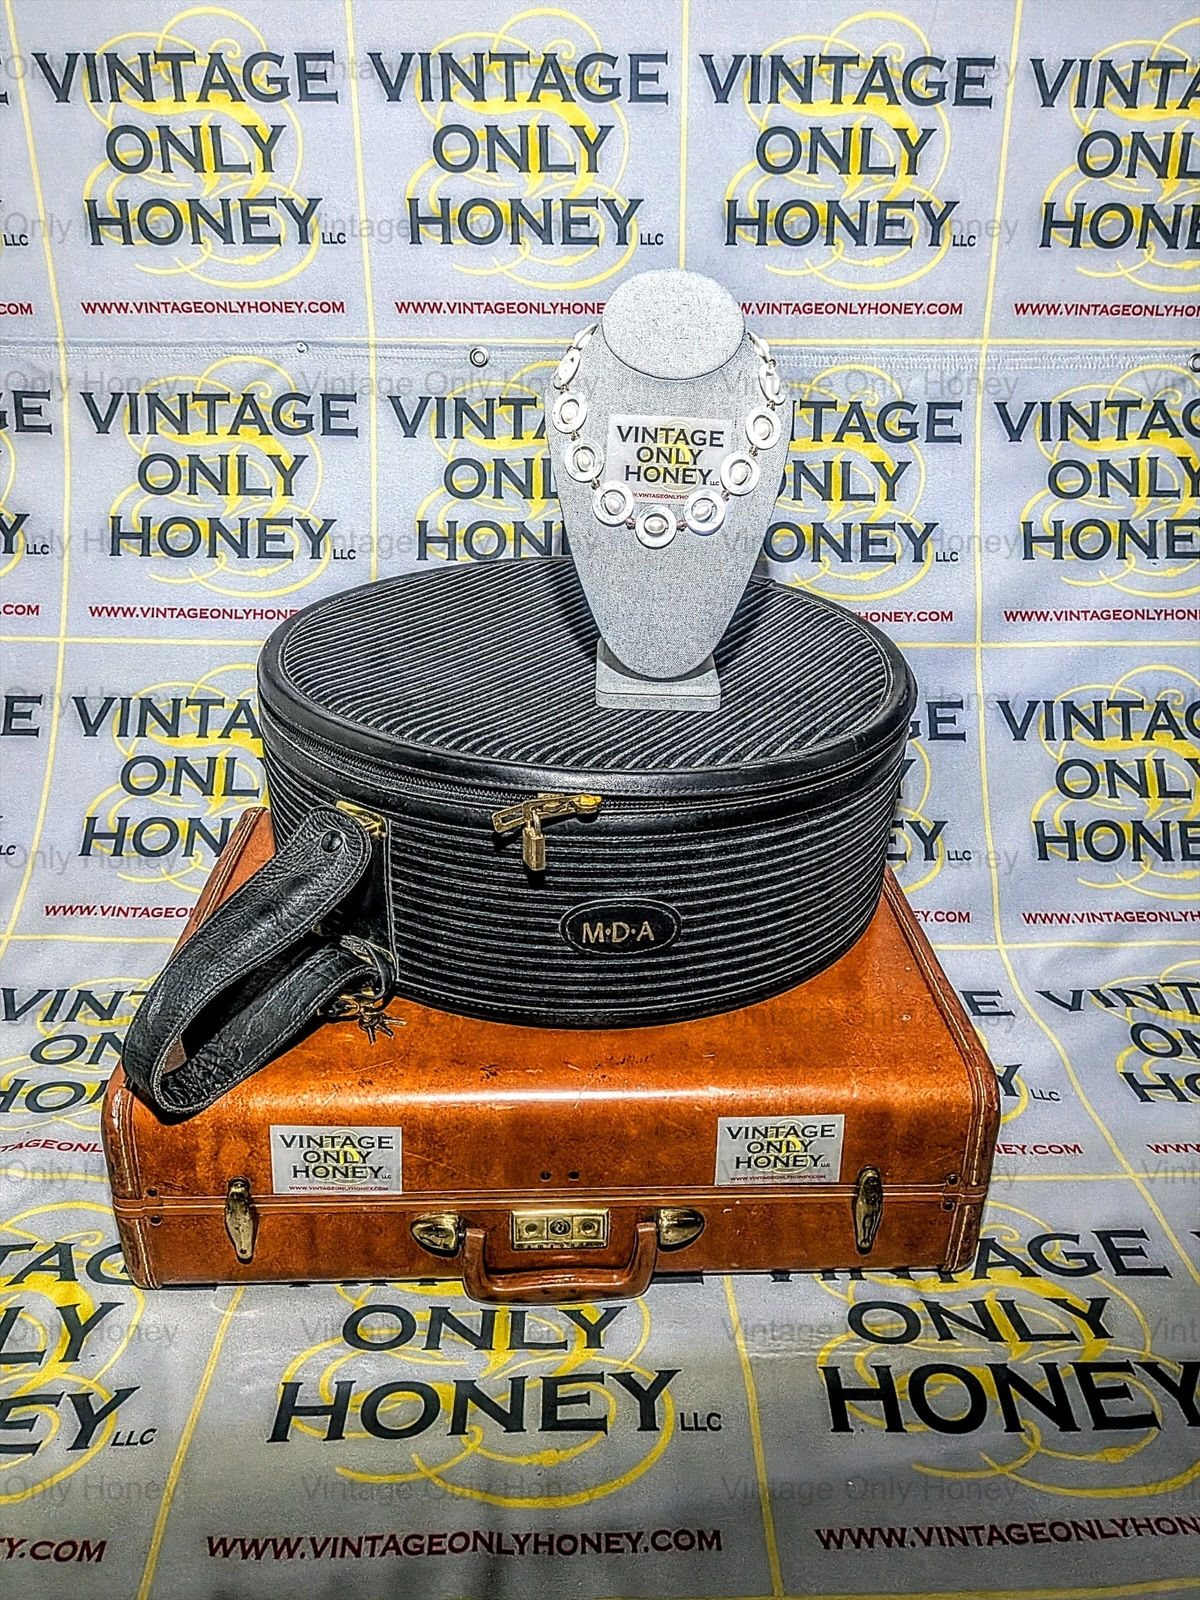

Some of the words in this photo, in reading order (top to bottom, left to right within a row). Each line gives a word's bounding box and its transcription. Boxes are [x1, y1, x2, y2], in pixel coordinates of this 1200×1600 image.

[32, 51, 338, 104] VINTAGE
[367, 51, 668, 105] VINTAGE
[699, 54, 995, 109] VINTAGE
[106, 125, 286, 174] ONLY
[433, 125, 614, 174] ONLY
[756, 126, 937, 177] ONLY
[4, 234, 28, 246] LLC
[85, 197, 322, 246] HONEY
[322, 233, 346, 245] LLC
[408, 197, 644, 247] HONEY
[640, 233, 664, 245] LLC
[725, 199, 959, 248] HONEY
[953, 235, 976, 246] LLC
[82, 302, 345, 314] WWW.VINTAGEONLYHONEY.COM
[80, 390, 358, 438] VINTAGE
[790, 398, 963, 445] TAGE
[617, 426, 724, 448] VINTAGE
[636, 446, 704, 465] ONLY
[138, 454, 308, 497] ONLY
[625, 465, 713, 486] HONEY
[777, 460, 912, 502] NLY
[26, 544, 49, 554] LLC
[110, 516, 337, 560] HONEY
[333, 549, 356, 560] LLC
[936, 552, 958, 562] LLC
[121, 756, 264, 798] ONL
[947, 850, 972, 861] LLC
[1030, 1089, 1061, 1102] LLC
[279, 1134, 394, 1149] VINTAGE
[726, 1123, 836, 1140] VINTAGE
[746, 1139, 815, 1155] ONLY
[292, 1165, 384, 1179] HONEY
[302, 1150, 373, 1164] ONLY
[735, 1154, 825, 1170] HONEY
[343, 1304, 627, 1351] ONLY
[848, 1297, 1117, 1345] ONLY
[266, 1369, 682, 1443] HONEY
[680, 1412, 723, 1432] LLC
[111, 1428, 157, 1446] LLC
[206, 1529, 723, 1560] WWW.VINTAGEONLYHONEY.COM
